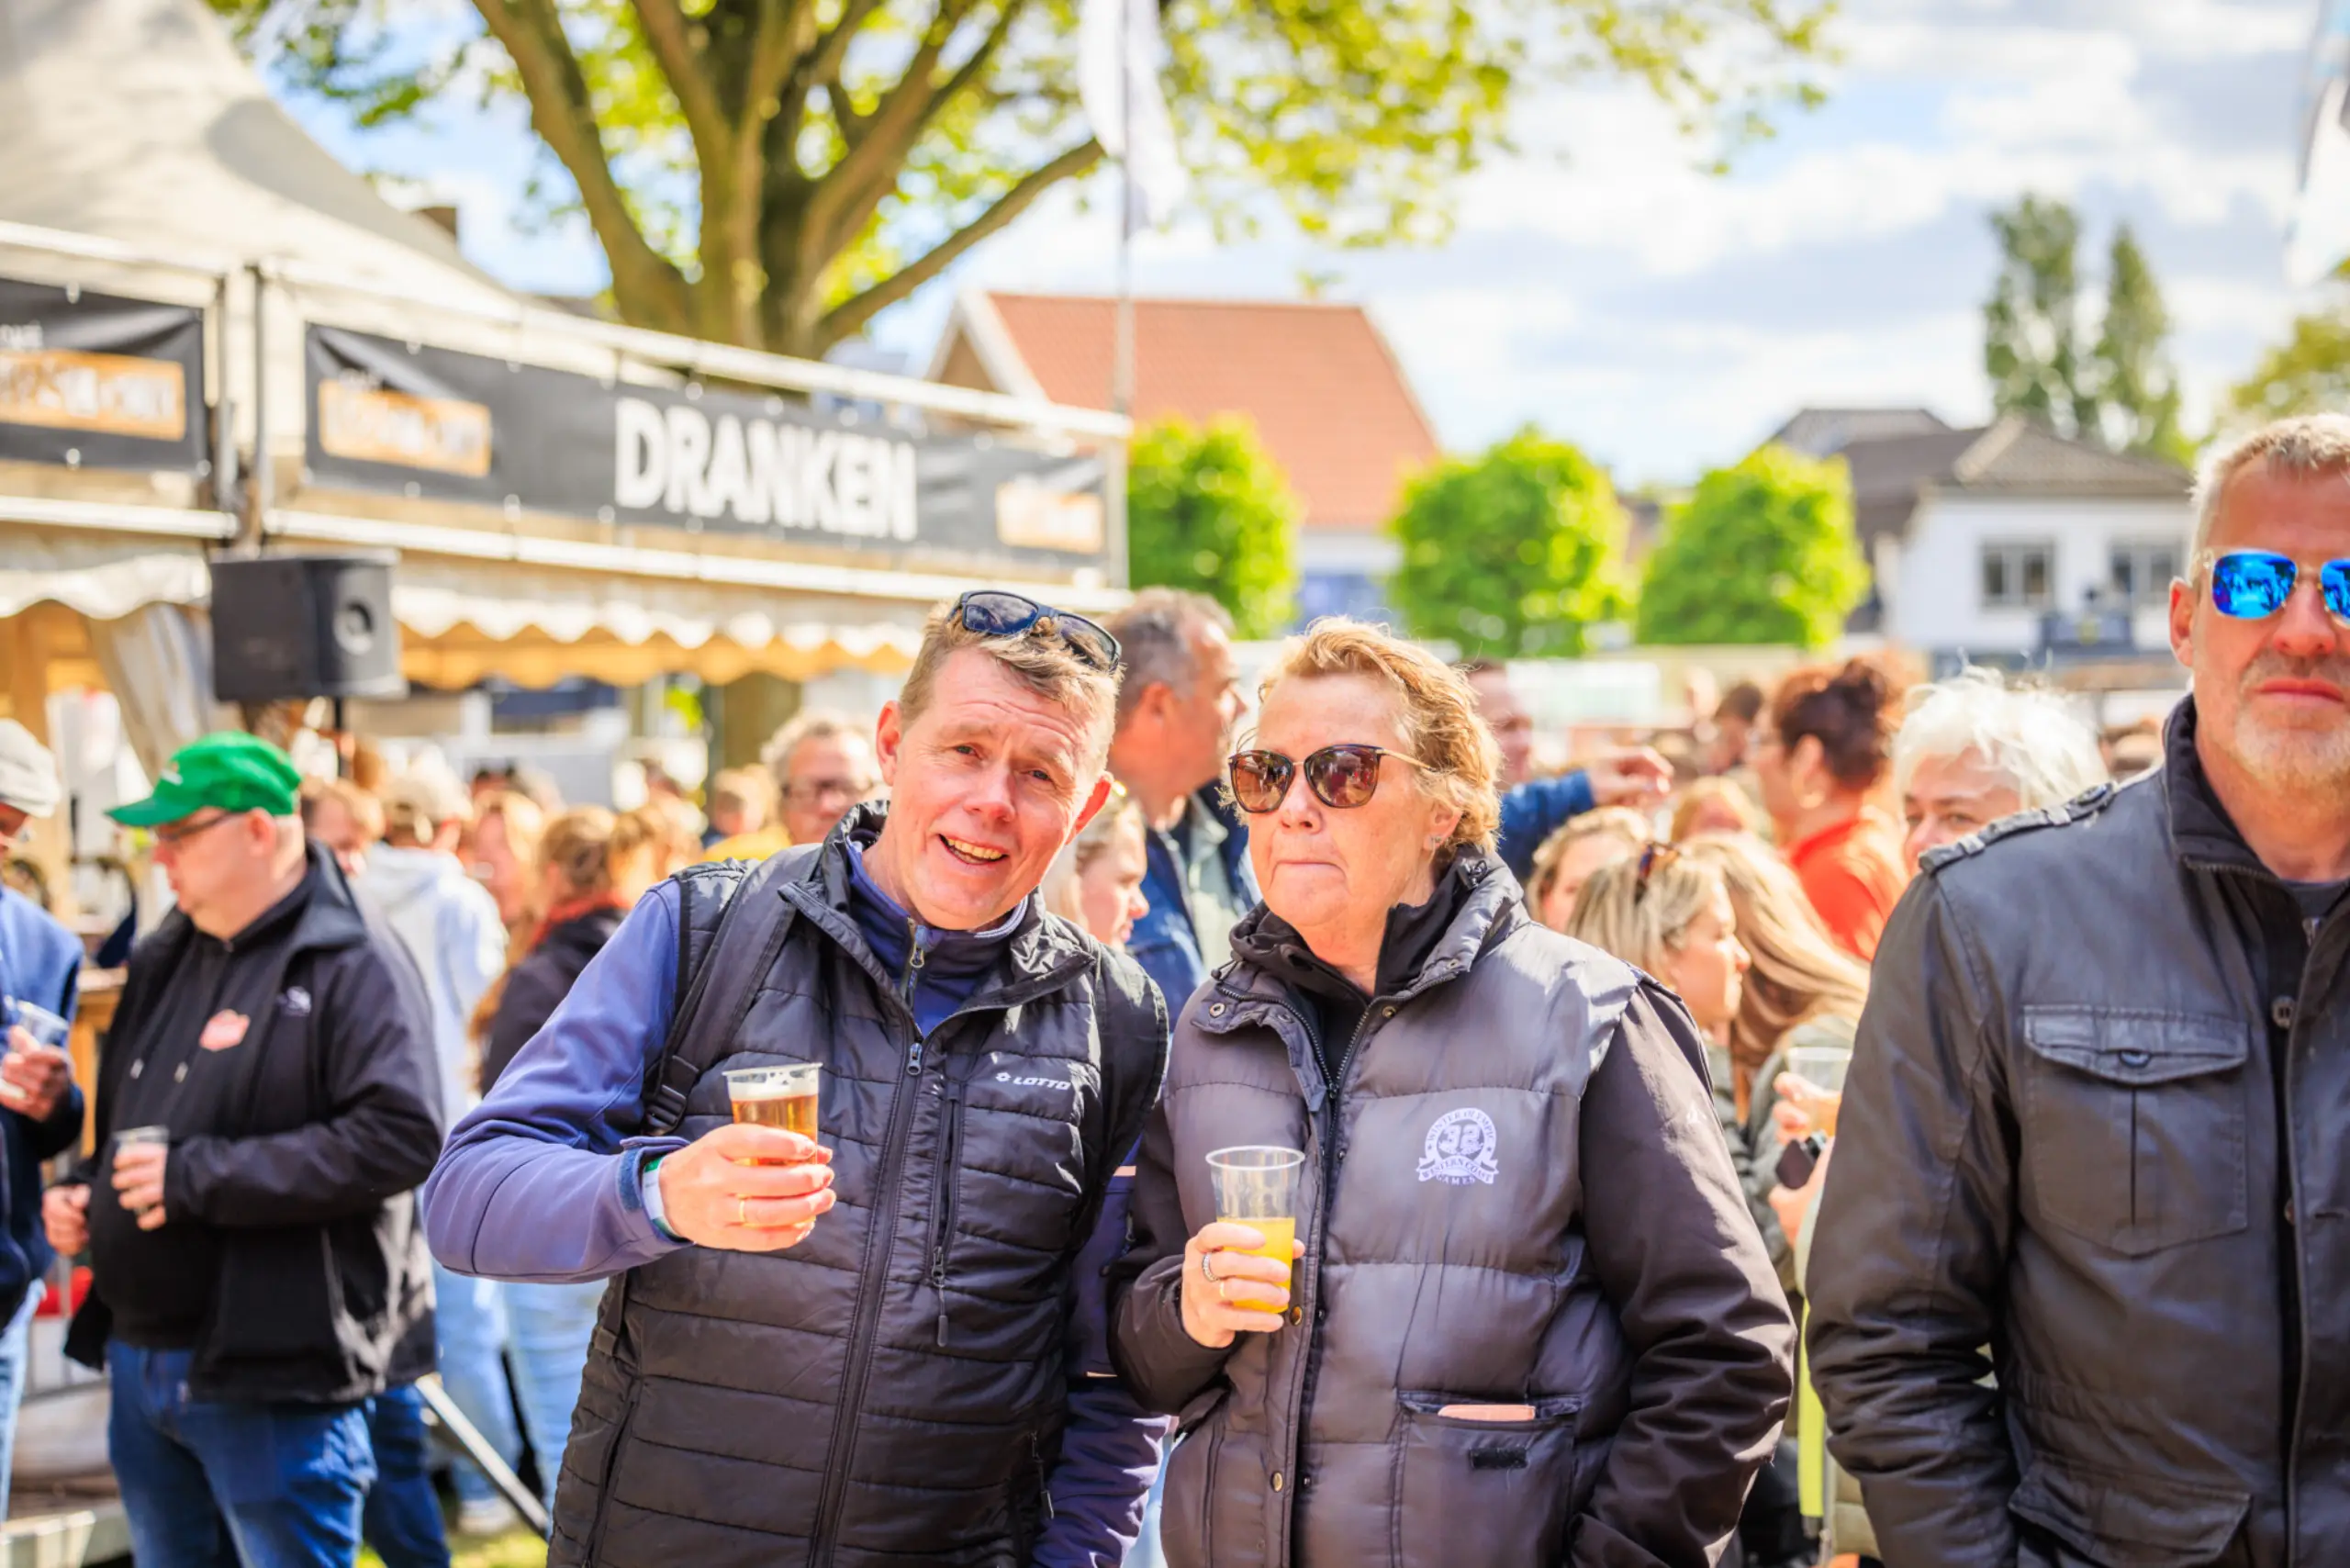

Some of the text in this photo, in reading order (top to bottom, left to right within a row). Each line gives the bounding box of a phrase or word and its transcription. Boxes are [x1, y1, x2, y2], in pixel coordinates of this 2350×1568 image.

[614, 396, 918, 543] DRANKEN
[1013, 1076, 1071, 1091] LOTTO
[1427, 1109, 1494, 1141] WINTER OLYMPIC
[1421, 1158, 1493, 1182] WESTERN COAST
[1436, 1174, 1476, 1185] GAMES
